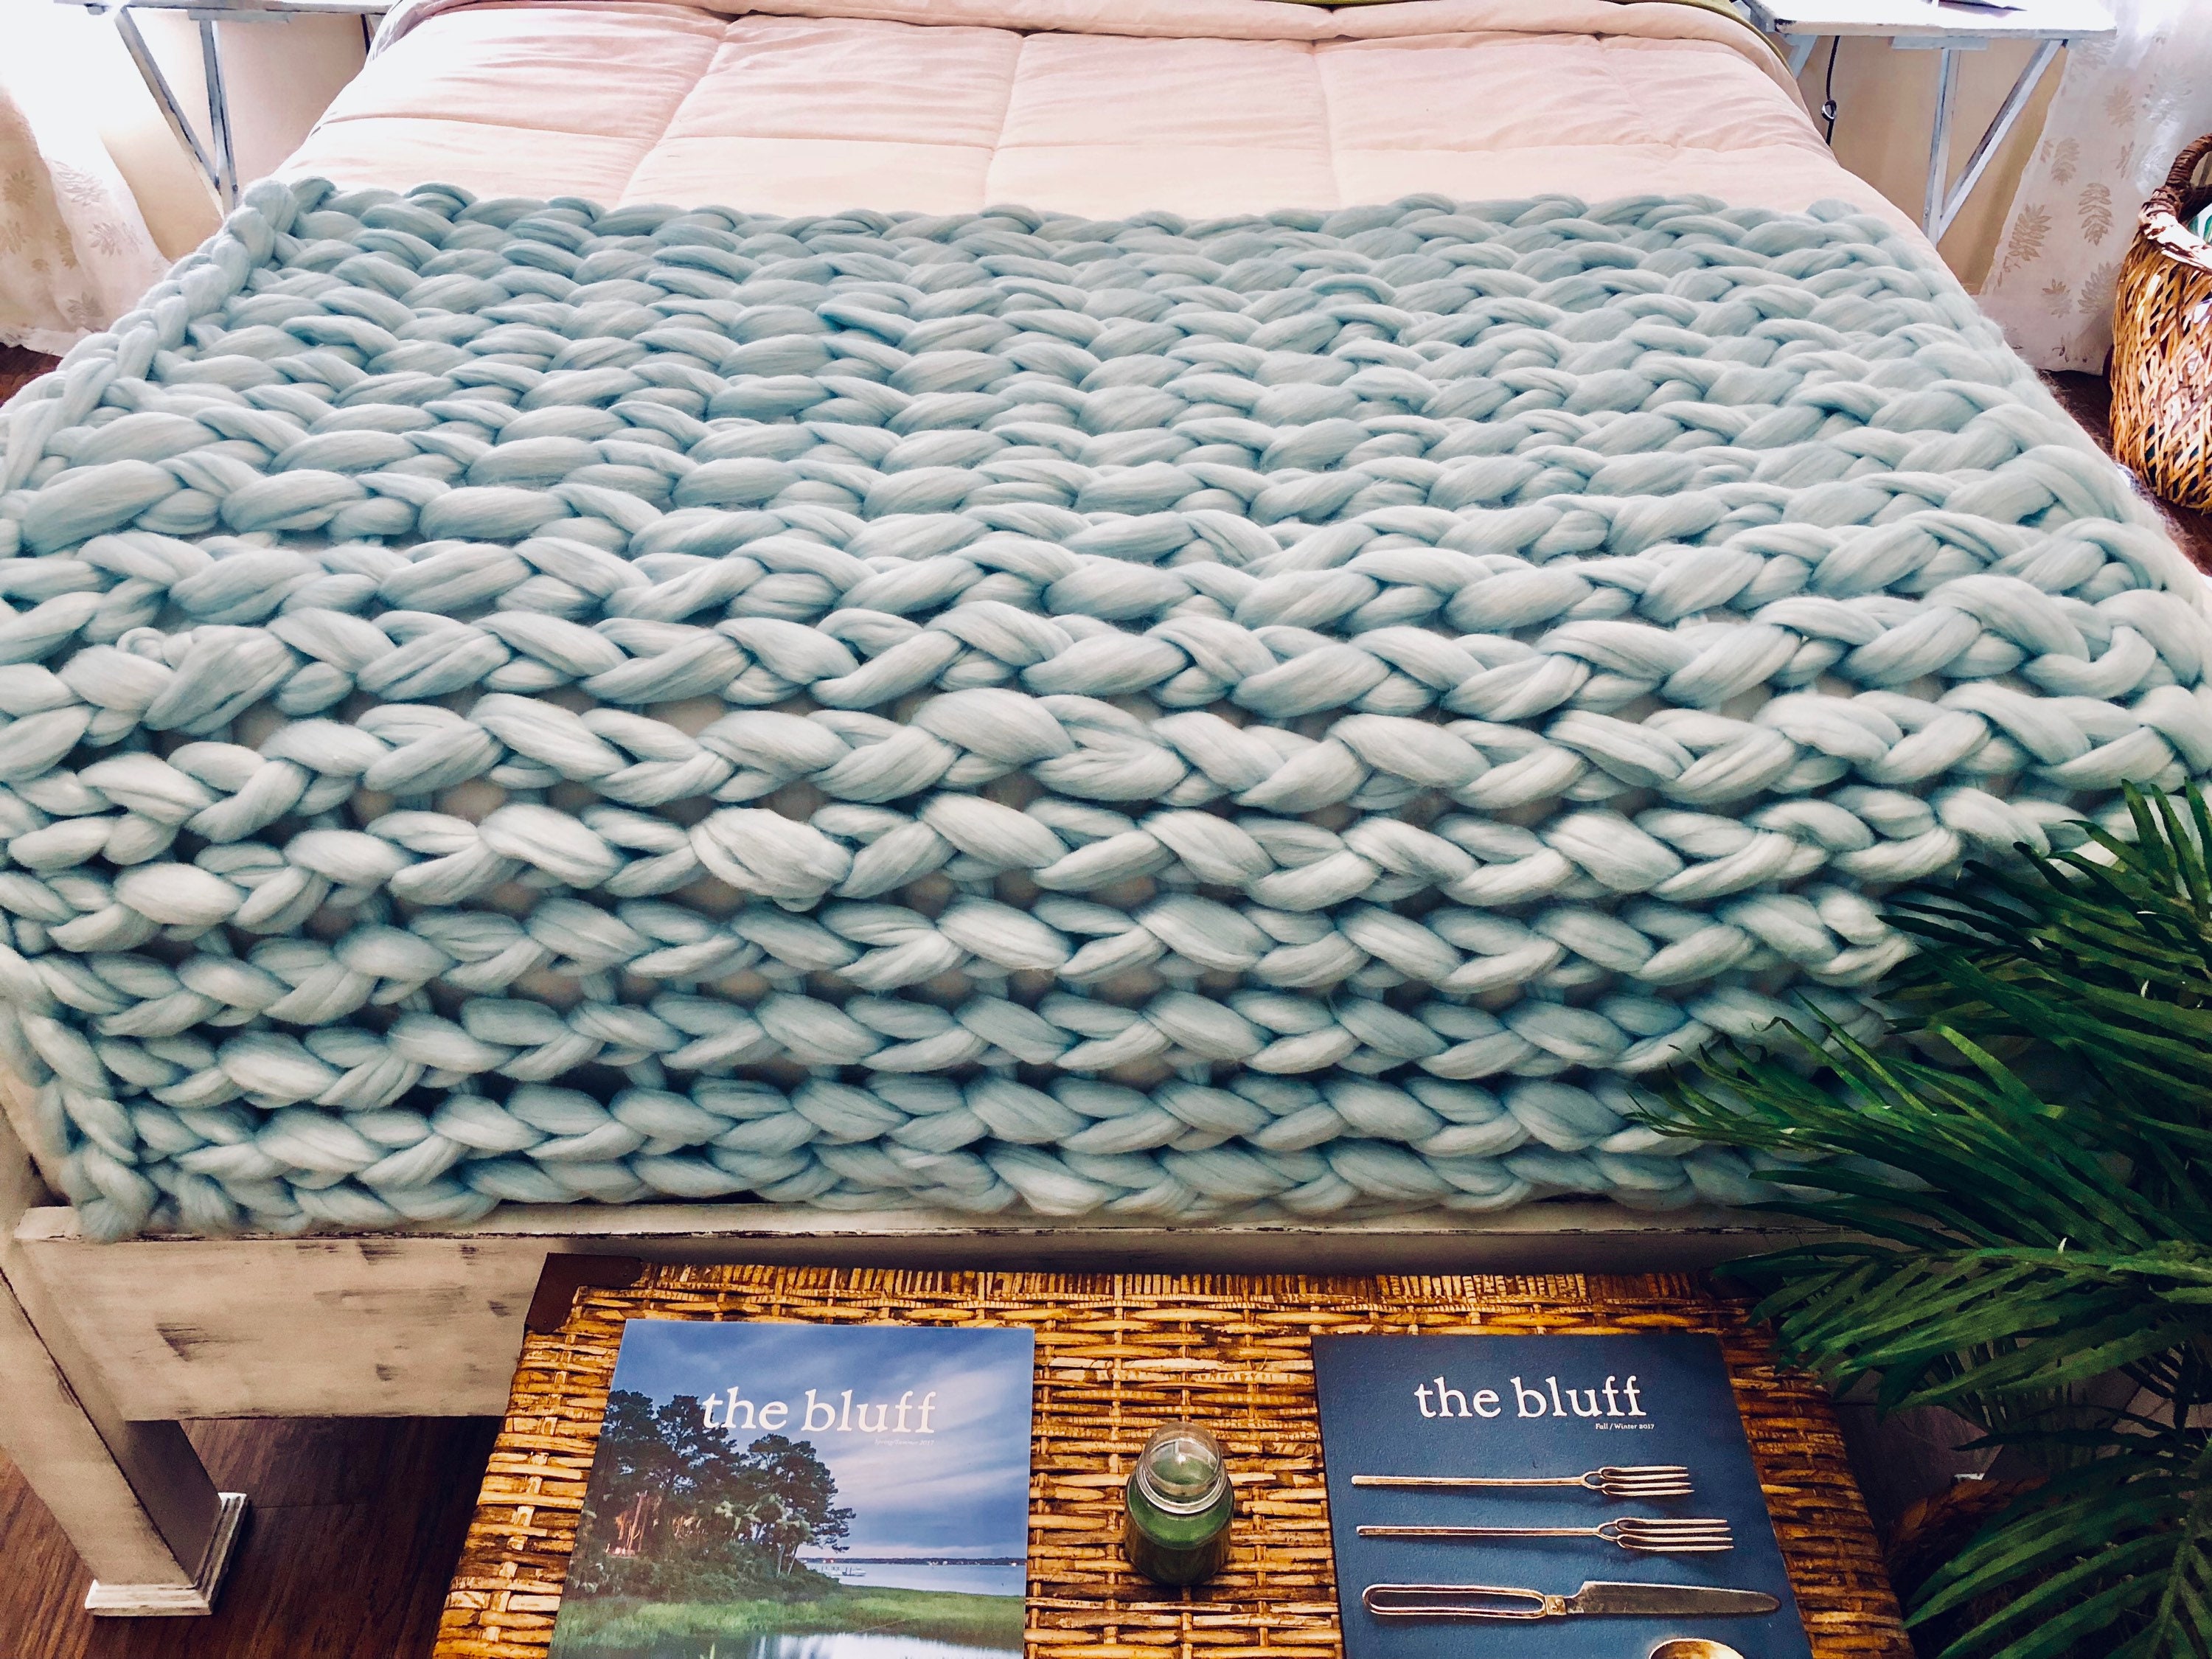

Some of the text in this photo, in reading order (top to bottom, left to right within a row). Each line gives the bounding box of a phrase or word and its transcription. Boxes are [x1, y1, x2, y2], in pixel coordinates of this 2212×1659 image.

[702, 1386, 936, 1433] the bluff
[1413, 1375, 1646, 1418] the bluff
